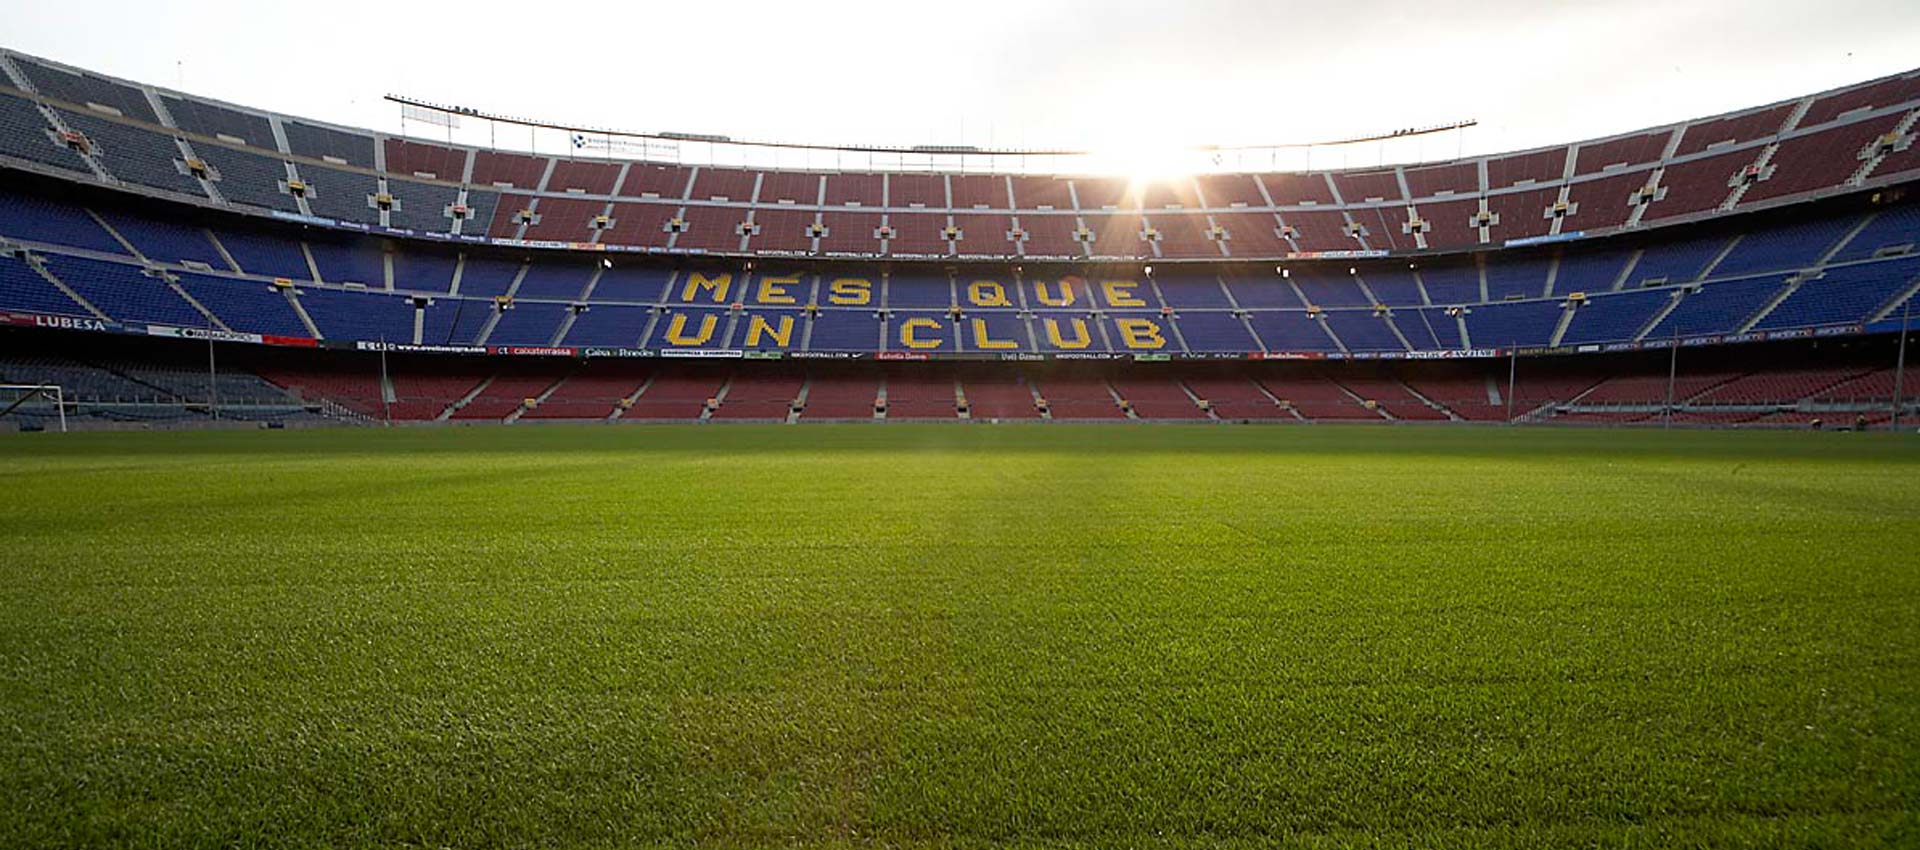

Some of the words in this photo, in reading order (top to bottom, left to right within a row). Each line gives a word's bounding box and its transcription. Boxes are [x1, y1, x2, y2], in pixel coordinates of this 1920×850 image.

[967, 280, 1146, 307] QUE
[36, 315, 106, 331] LUBESA
[665, 313, 798, 347] UN
[900, 317, 1166, 348] CLUB
[514, 347, 571, 355] caixaterrassa
[585, 348, 610, 357] Caixa
